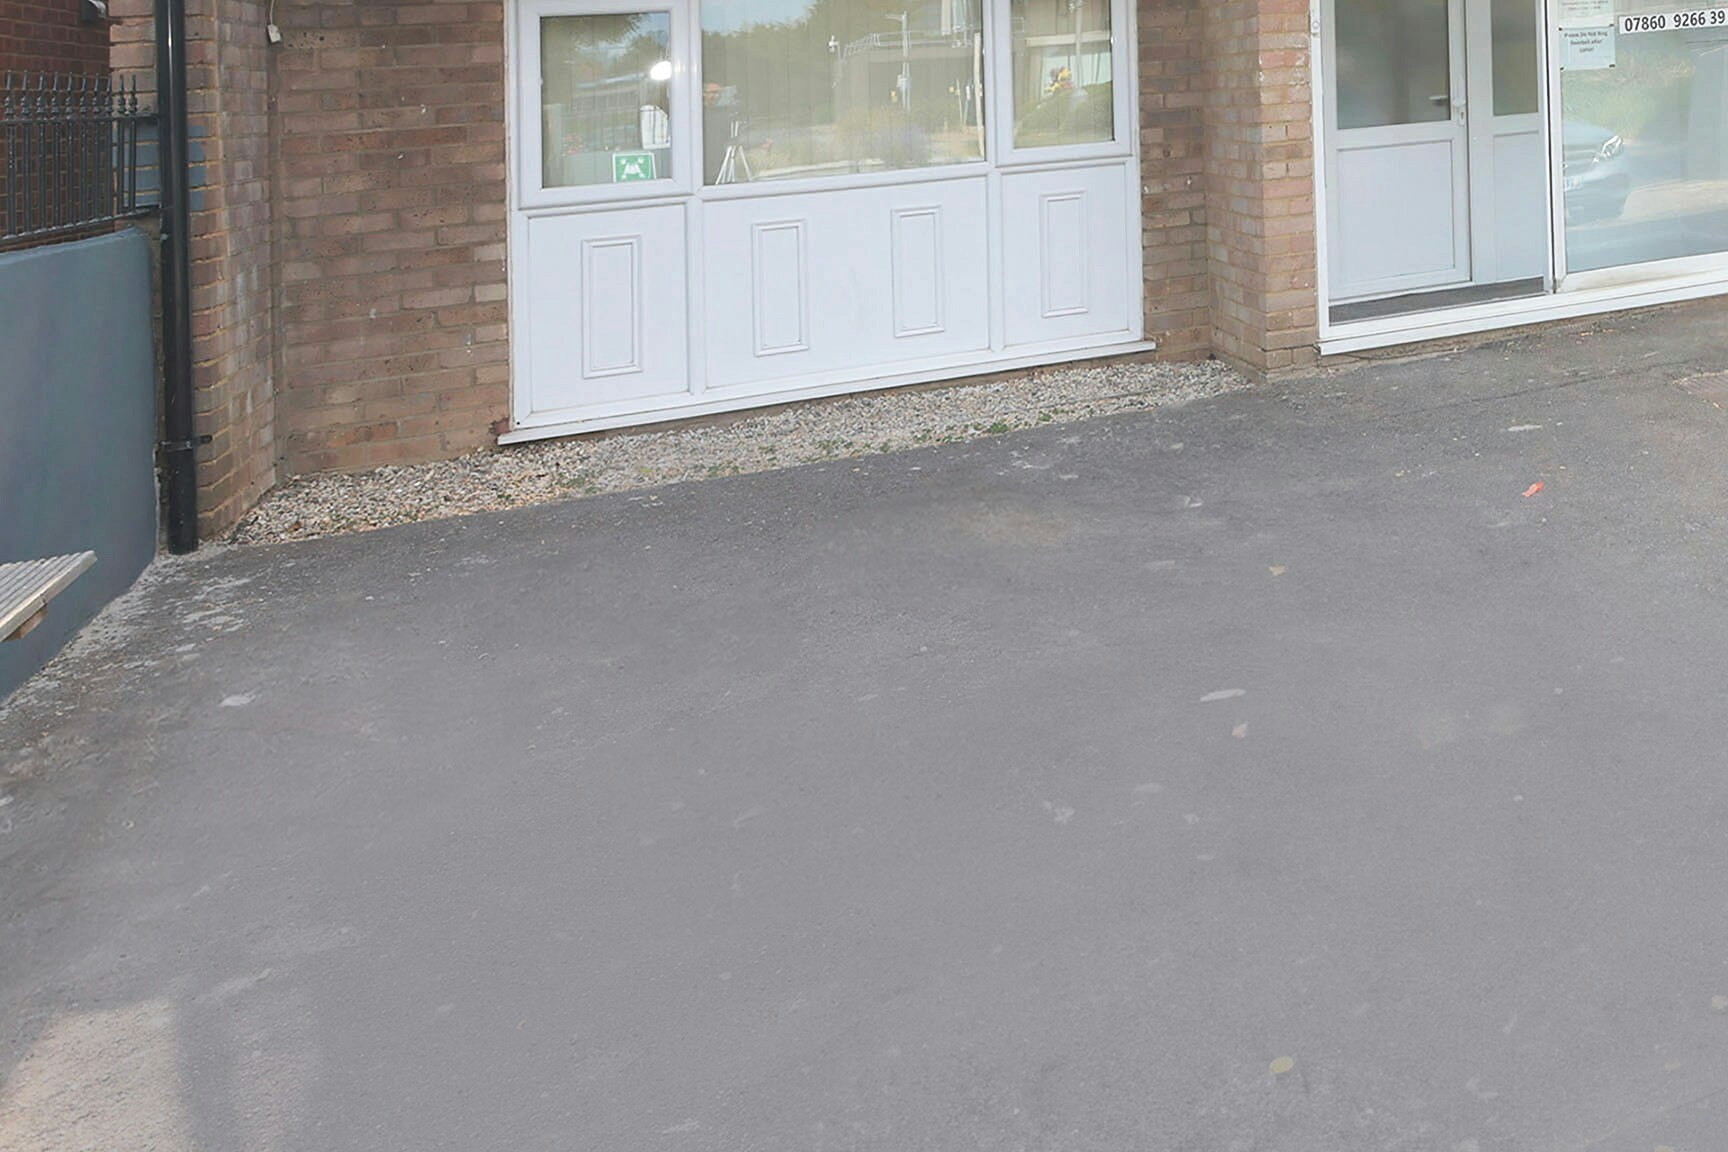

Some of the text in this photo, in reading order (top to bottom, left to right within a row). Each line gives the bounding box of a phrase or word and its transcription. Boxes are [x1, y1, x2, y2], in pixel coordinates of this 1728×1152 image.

[1624, 10, 1726, 32] 07860 9266 39
